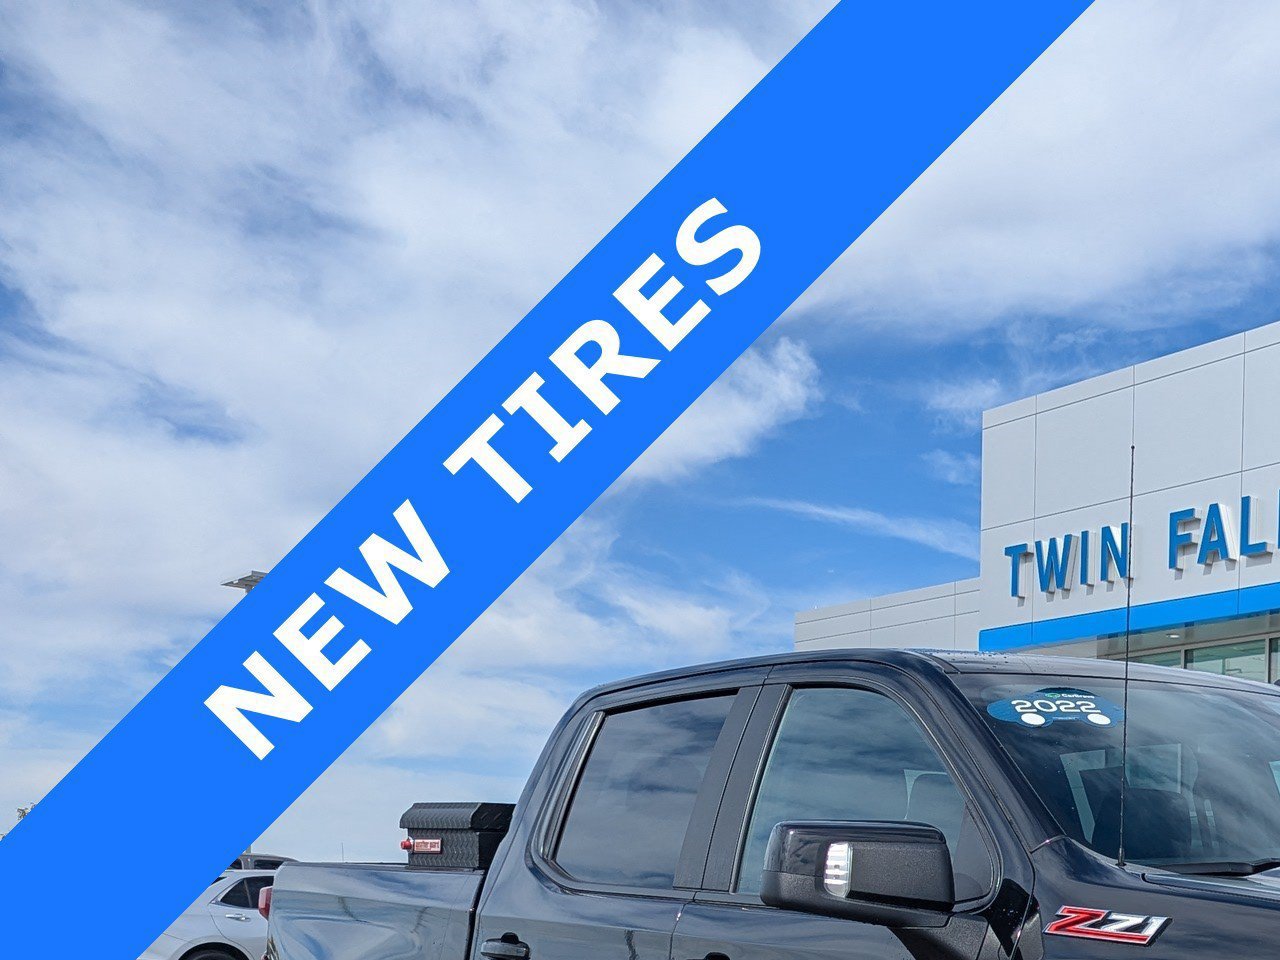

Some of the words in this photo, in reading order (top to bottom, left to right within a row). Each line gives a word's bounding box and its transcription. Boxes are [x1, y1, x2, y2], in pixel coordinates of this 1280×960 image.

[1004, 522, 1132, 599] TWIN
[1011, 699, 1101, 713] 2022
[1044, 905, 1173, 946] Z71
